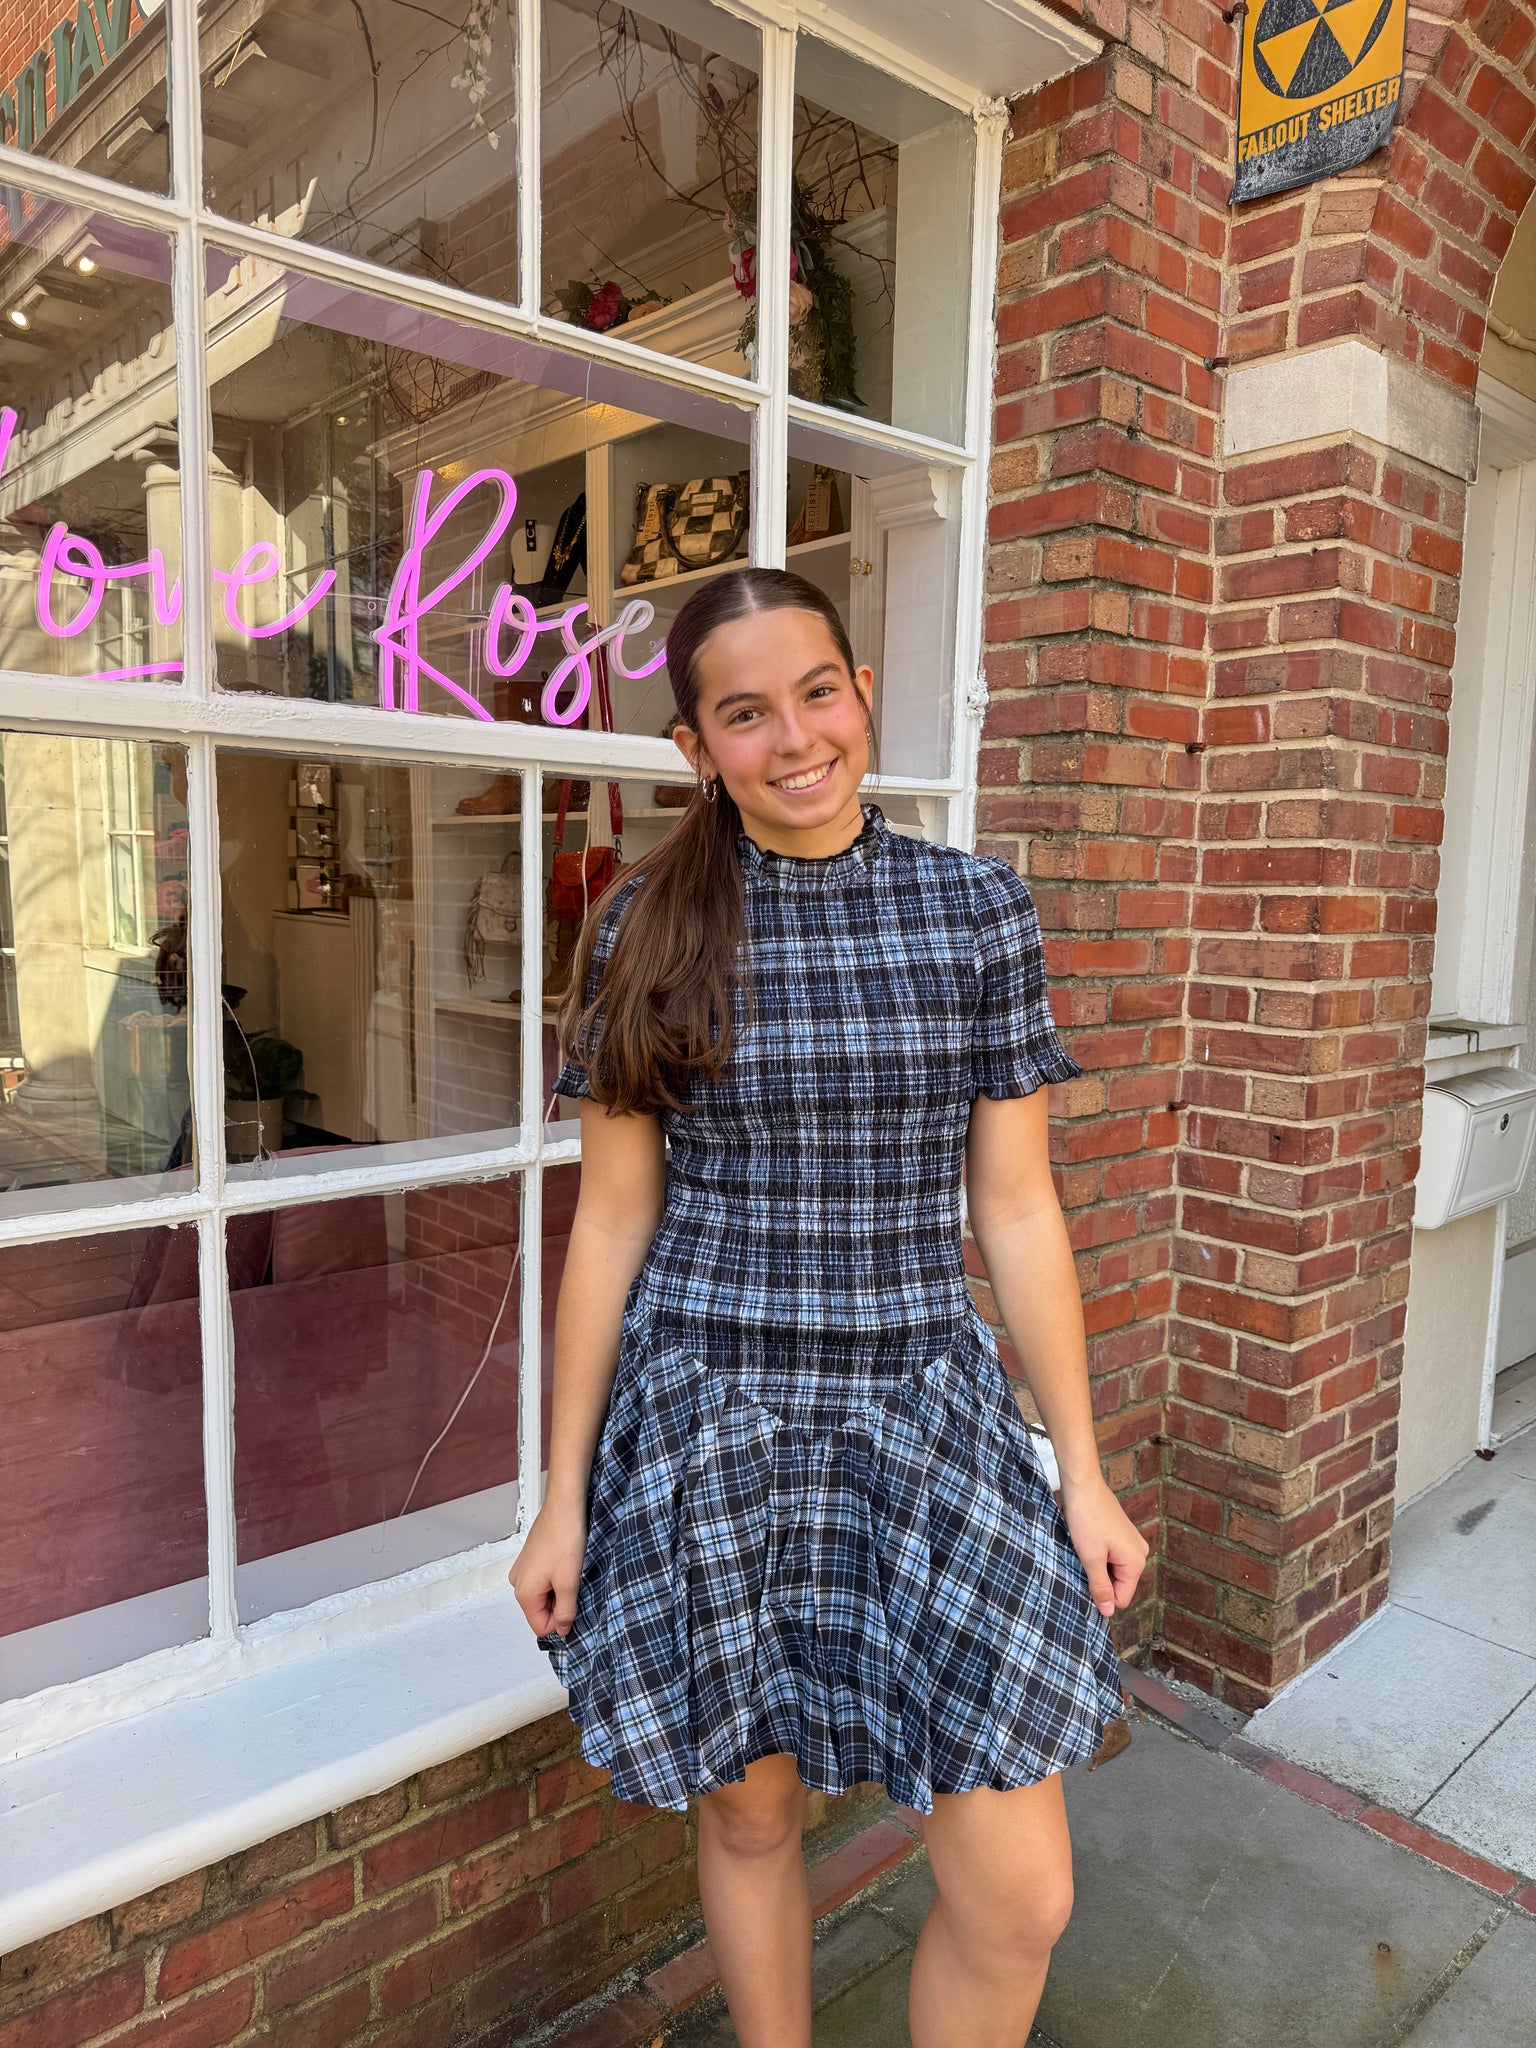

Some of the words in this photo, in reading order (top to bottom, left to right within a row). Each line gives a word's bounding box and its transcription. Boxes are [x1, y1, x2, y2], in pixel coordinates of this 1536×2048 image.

[1237, 112, 1311, 164] FALLOUT
[1317, 76, 1401, 131] SHELTER
[369, 468, 668, 726] Rose
